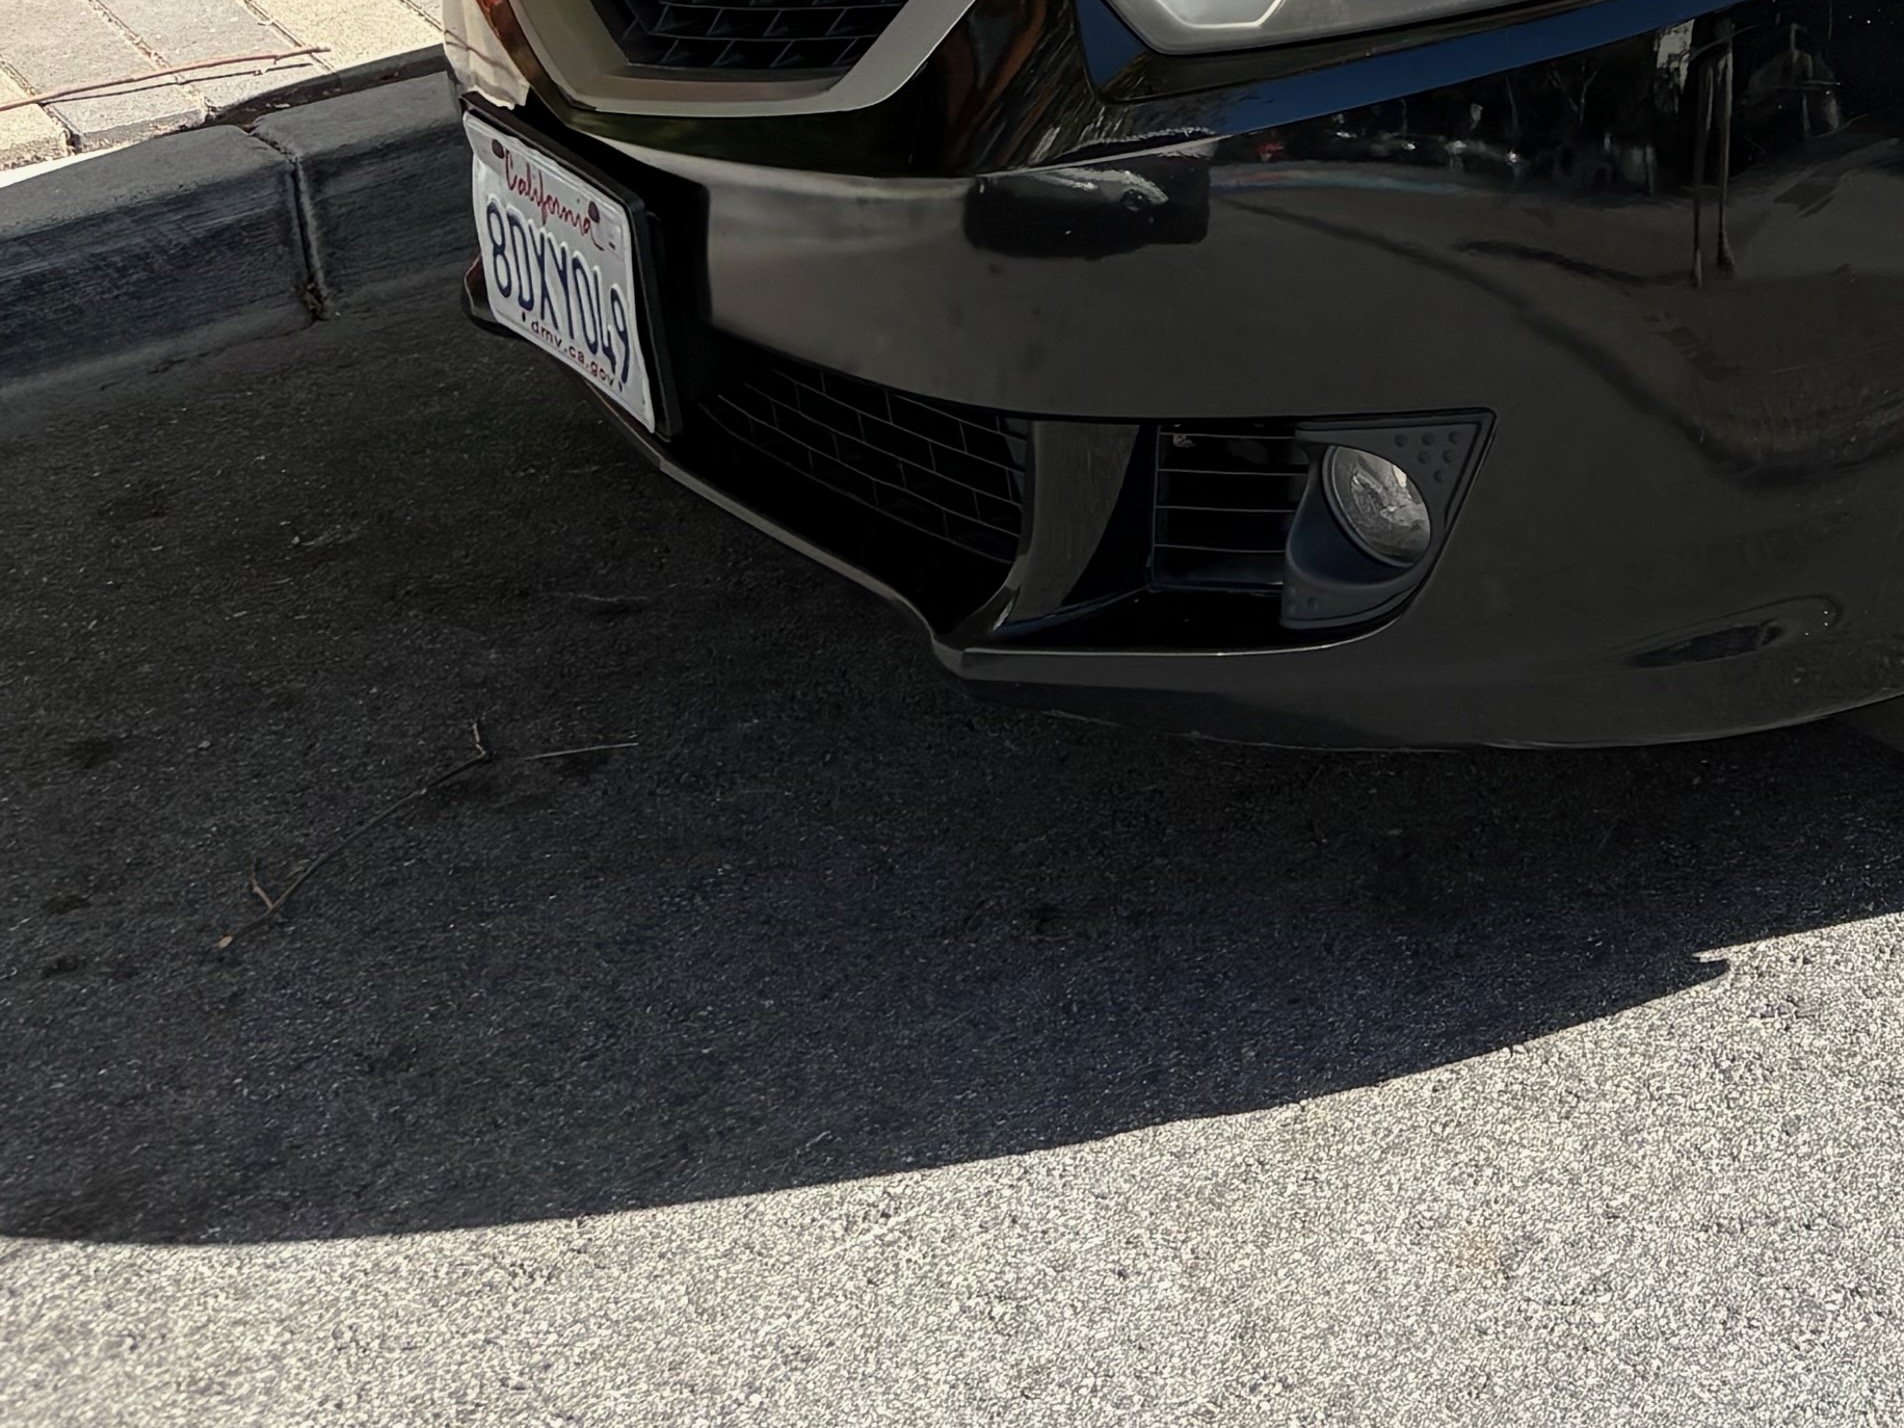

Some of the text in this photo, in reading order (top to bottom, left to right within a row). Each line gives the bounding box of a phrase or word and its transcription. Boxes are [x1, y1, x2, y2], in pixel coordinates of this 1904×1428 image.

[503, 150, 604, 251] California
[486, 203, 630, 383] 8DXY049
[530, 320, 616, 386] dmv.ca.gov
